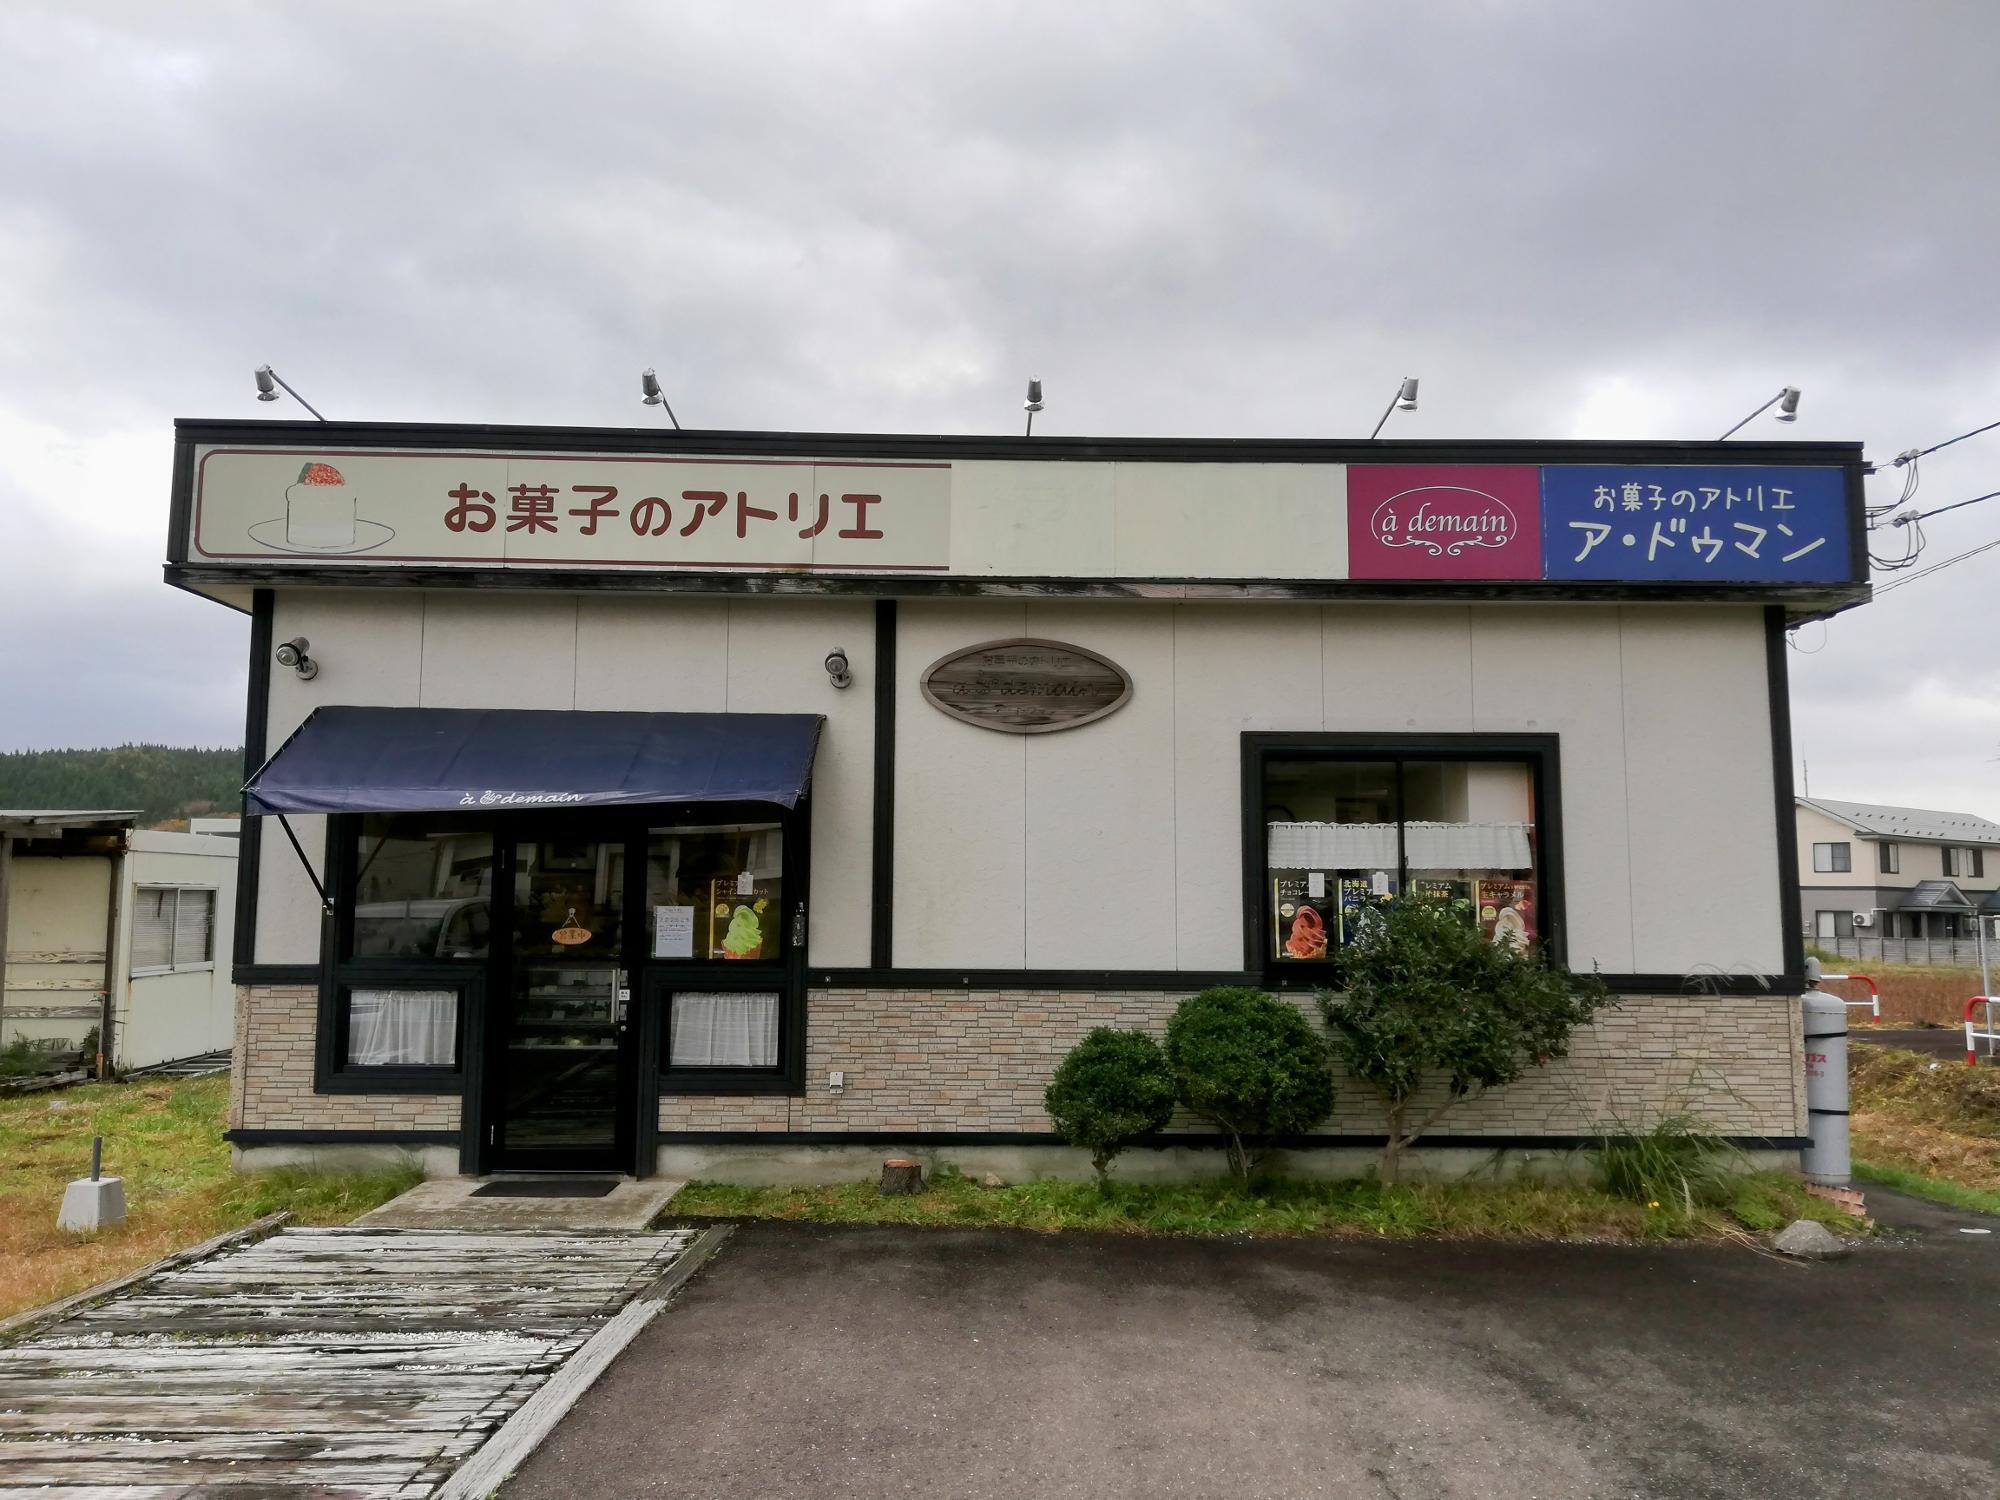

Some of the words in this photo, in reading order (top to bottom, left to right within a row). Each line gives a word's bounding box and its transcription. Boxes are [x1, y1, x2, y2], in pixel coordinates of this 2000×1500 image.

[444, 482, 884, 539] お菓子のアトリエ
[1595, 483, 1794, 512] お菓子のアトリエ
[1382, 507, 1399, 531] à
[1408, 502, 1508, 532] demain
[1569, 519, 1825, 562] ア・ドゥマン
[459, 793, 476, 805] à
